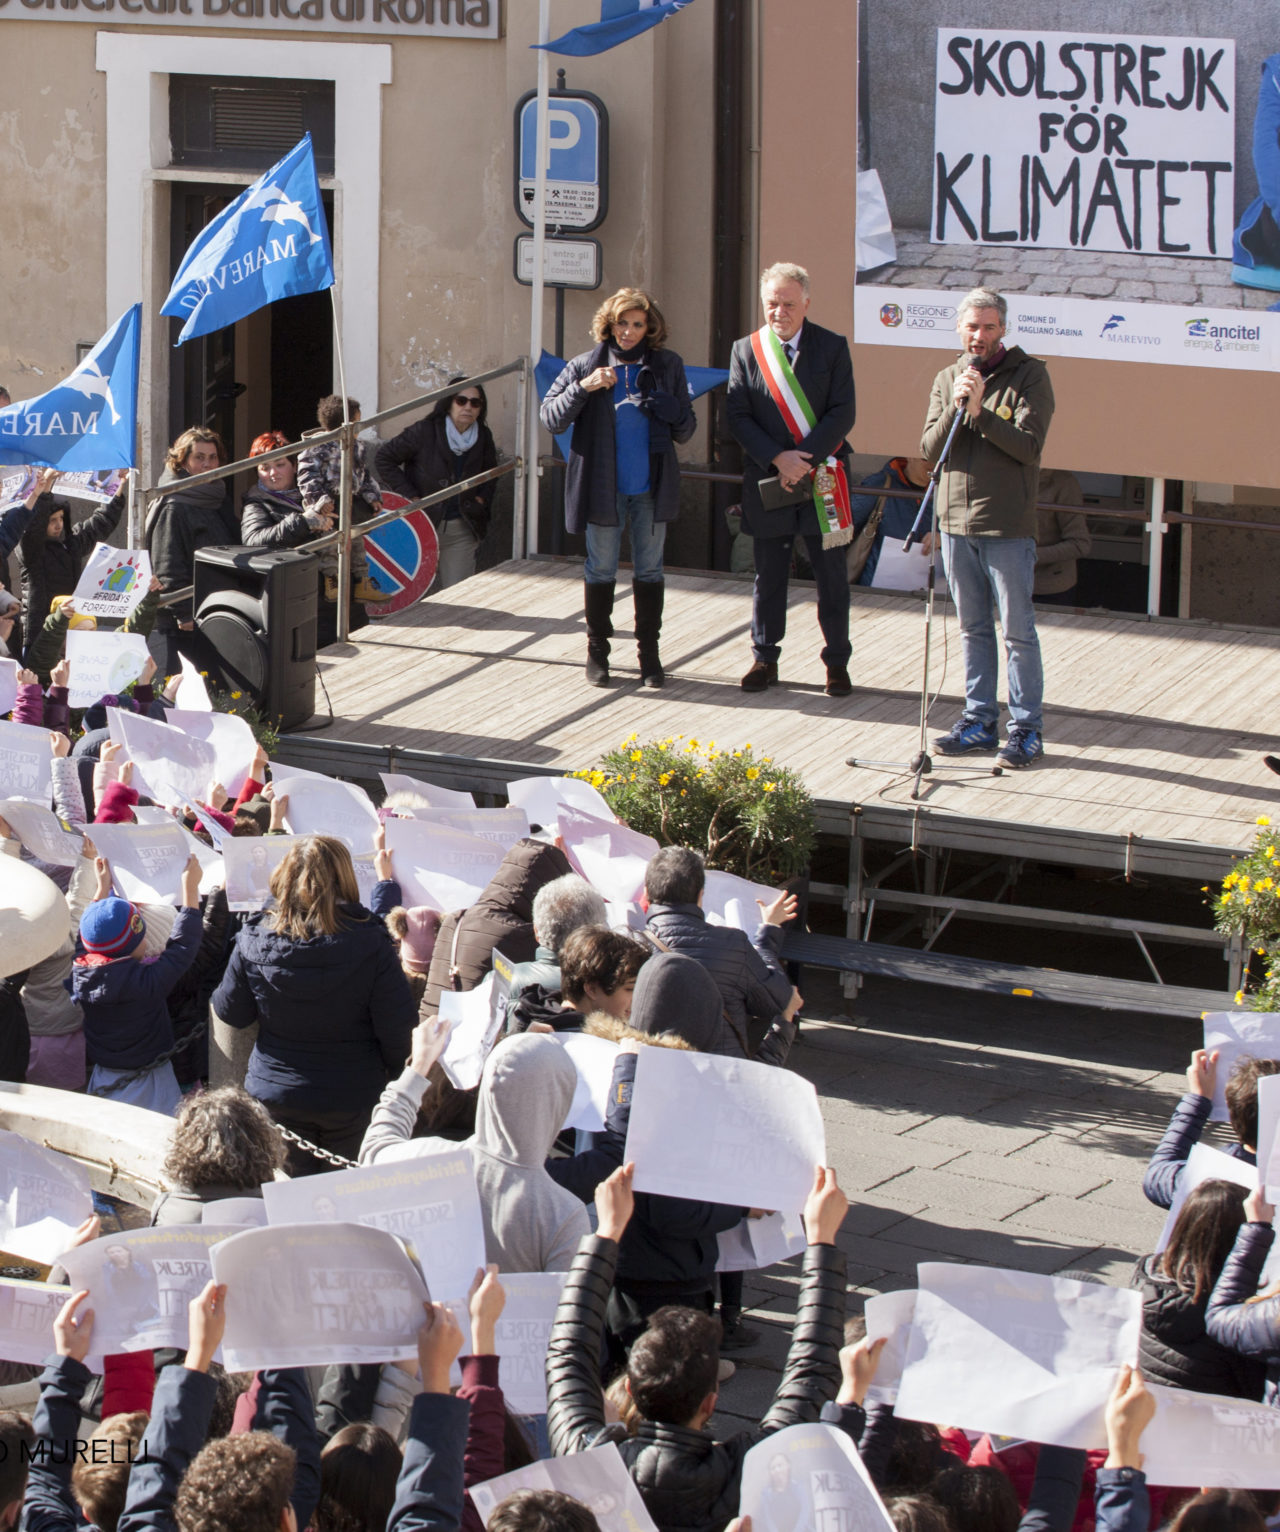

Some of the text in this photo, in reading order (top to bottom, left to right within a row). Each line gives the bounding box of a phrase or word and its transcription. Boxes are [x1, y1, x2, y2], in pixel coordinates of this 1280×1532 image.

[939, 36, 1229, 112] SKOLSTREJK
[1039, 104, 1128, 156] FÖR
[546, 109, 581, 170] P
[936, 151, 1232, 255] KLIMATET
[907, 305, 948, 316] REGIONE
[906, 319, 935, 328] LAZIO
[1018, 314, 1056, 324] COMUNE DI
[1018, 326, 1083, 337] MAGLIANO SABINA
[1210, 326, 1260, 340] ancitel
[1107, 334, 1161, 345] MAREVIVO
[93, 591, 131, 604] #FRIDAYS
[81, 602, 129, 615] FORFUTURE
